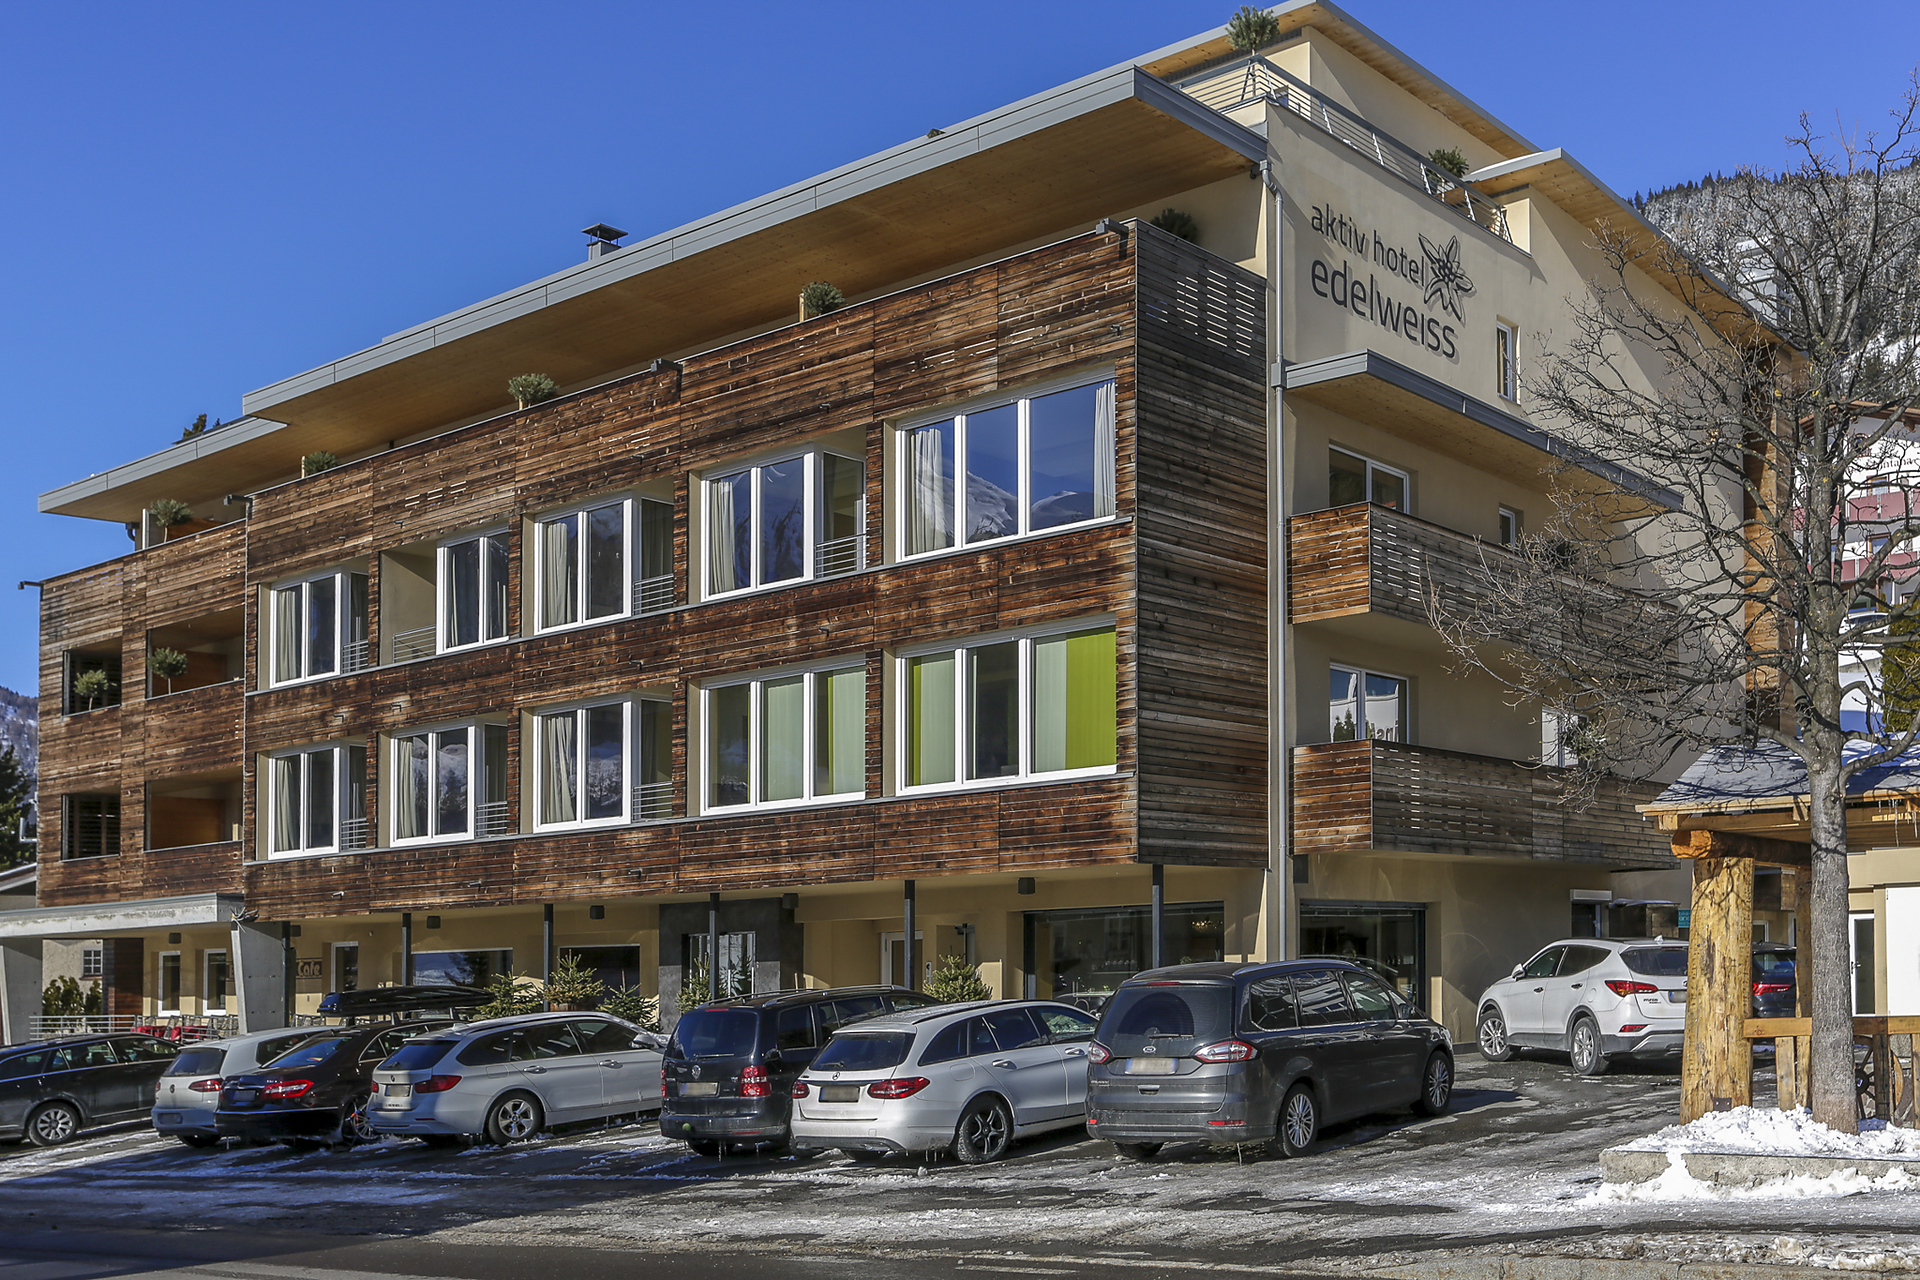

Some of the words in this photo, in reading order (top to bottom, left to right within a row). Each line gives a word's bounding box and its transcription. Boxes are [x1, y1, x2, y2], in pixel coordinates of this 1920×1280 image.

[1311, 203, 1366, 254] aktiv
[1373, 229, 1425, 287] hotel
[1311, 259, 1456, 359] edelweiss
